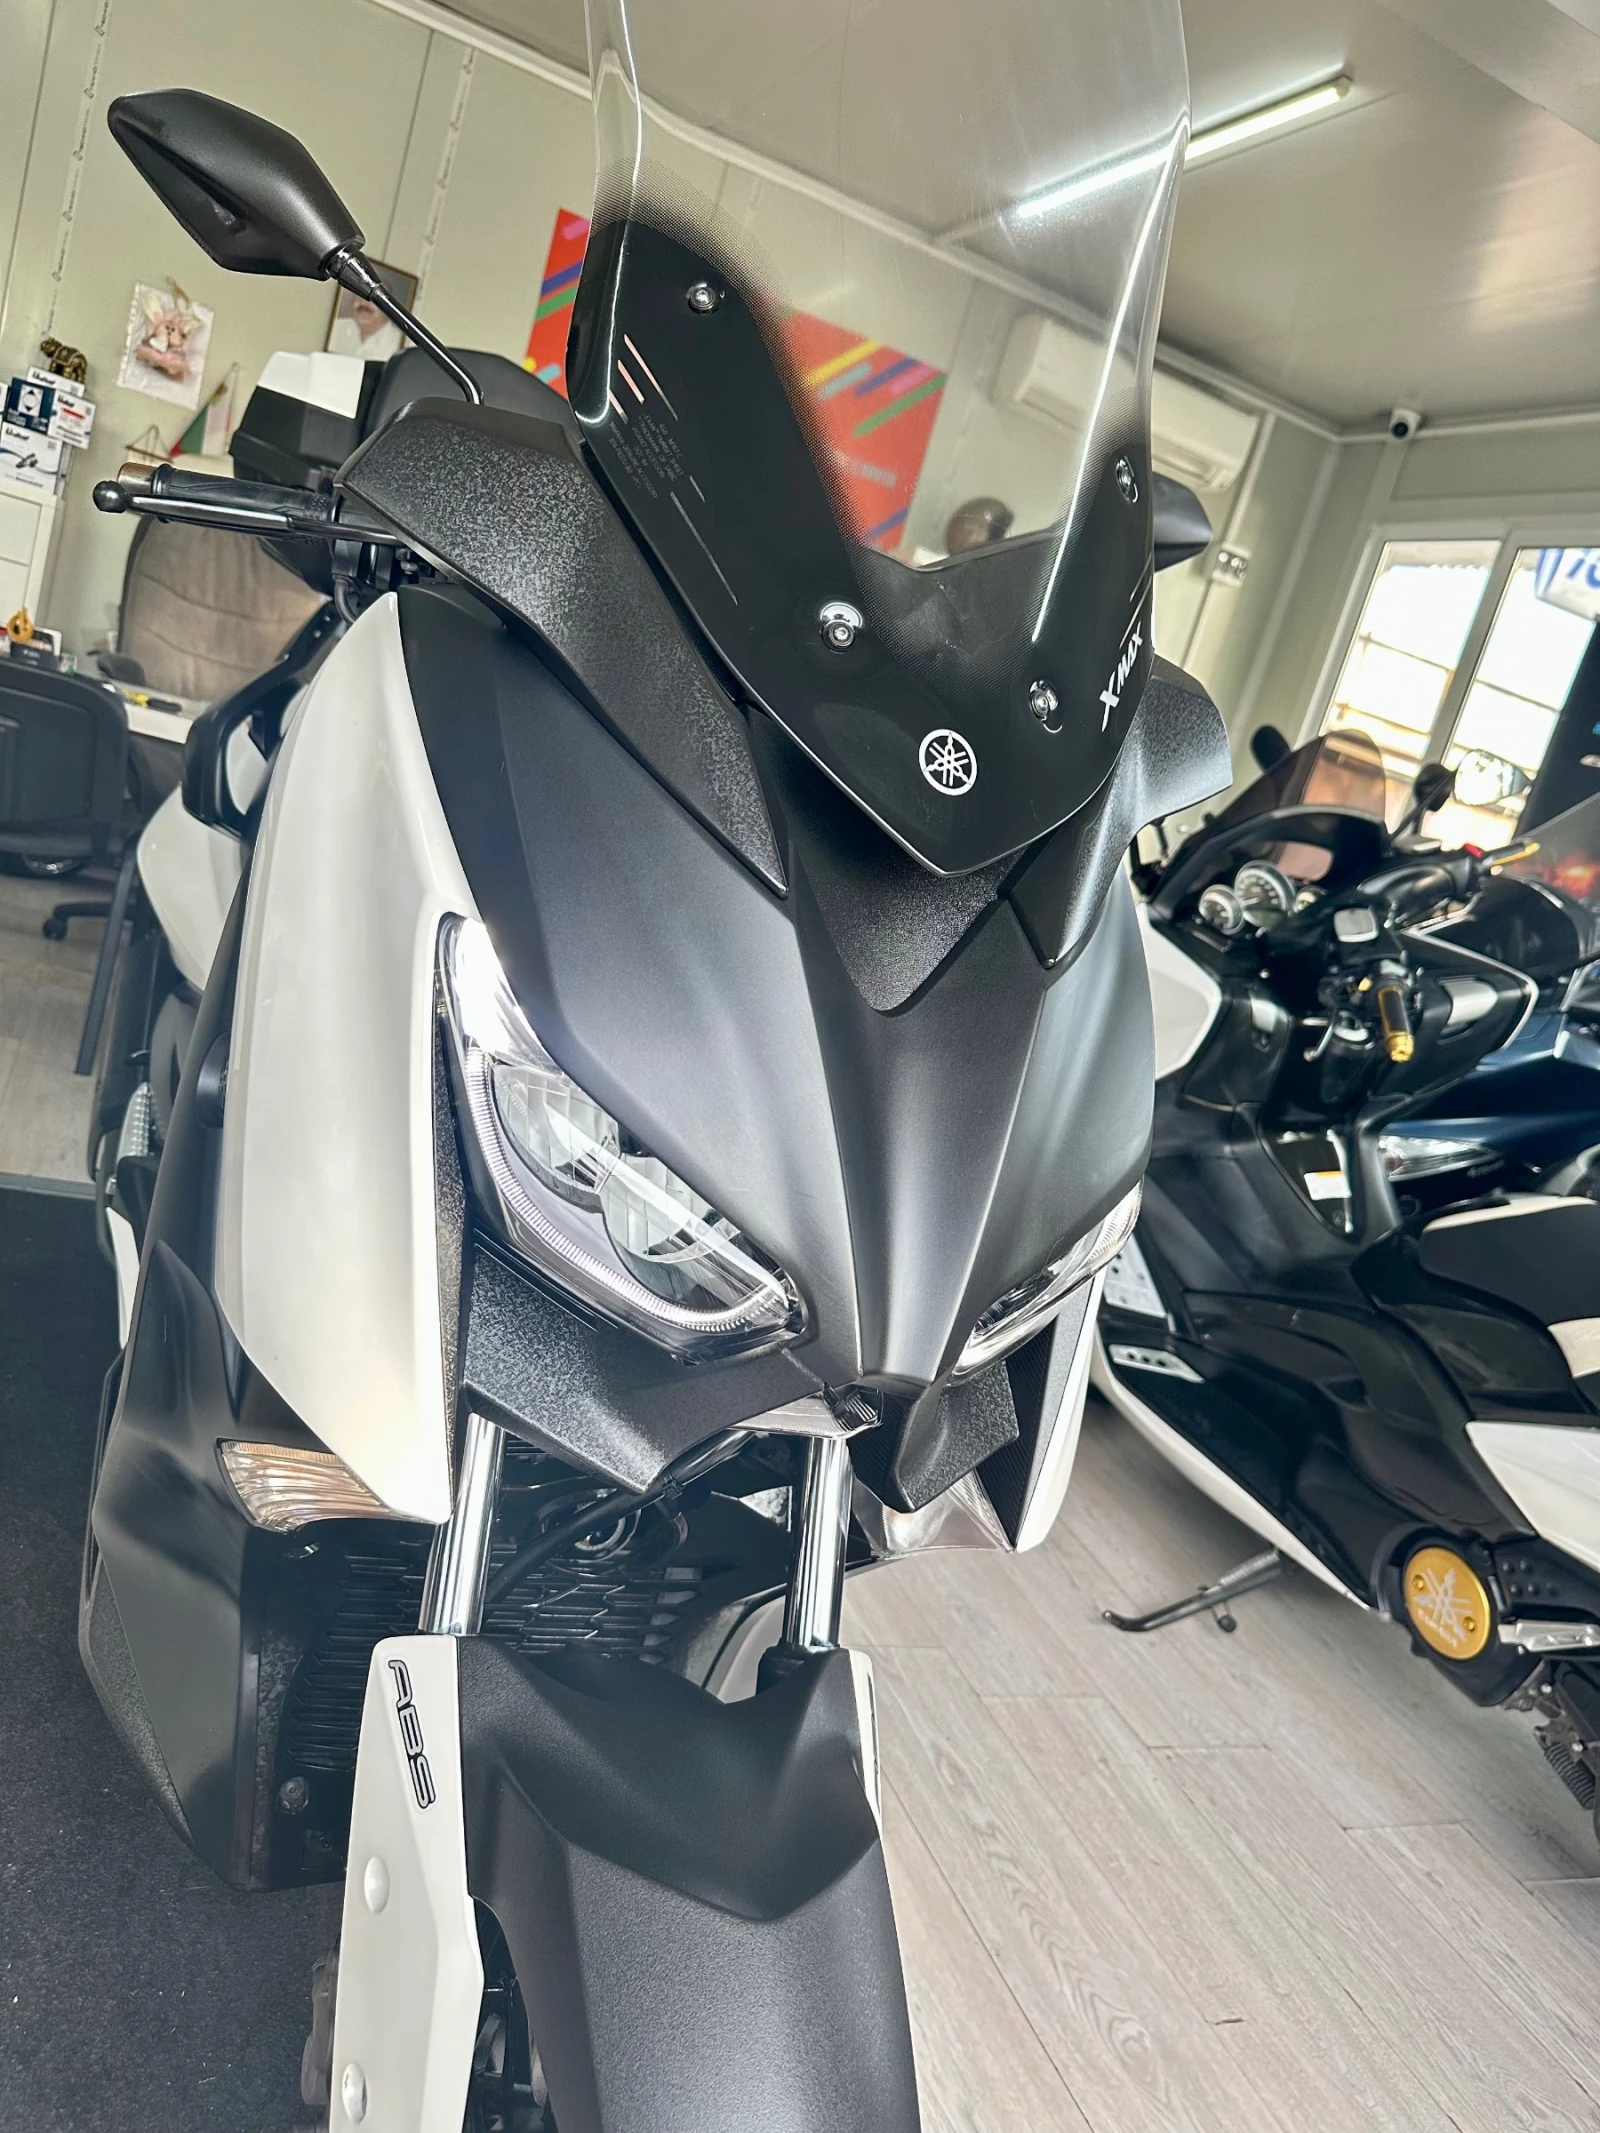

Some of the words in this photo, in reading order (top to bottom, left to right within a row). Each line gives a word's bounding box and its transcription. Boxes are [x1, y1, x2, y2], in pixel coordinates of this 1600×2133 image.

[608, 421, 625, 444] YAMAHA
[621, 443, 639, 468] GENUINE
[1099, 621, 1143, 732] XMAX
[388, 1660, 436, 1809] ABS
